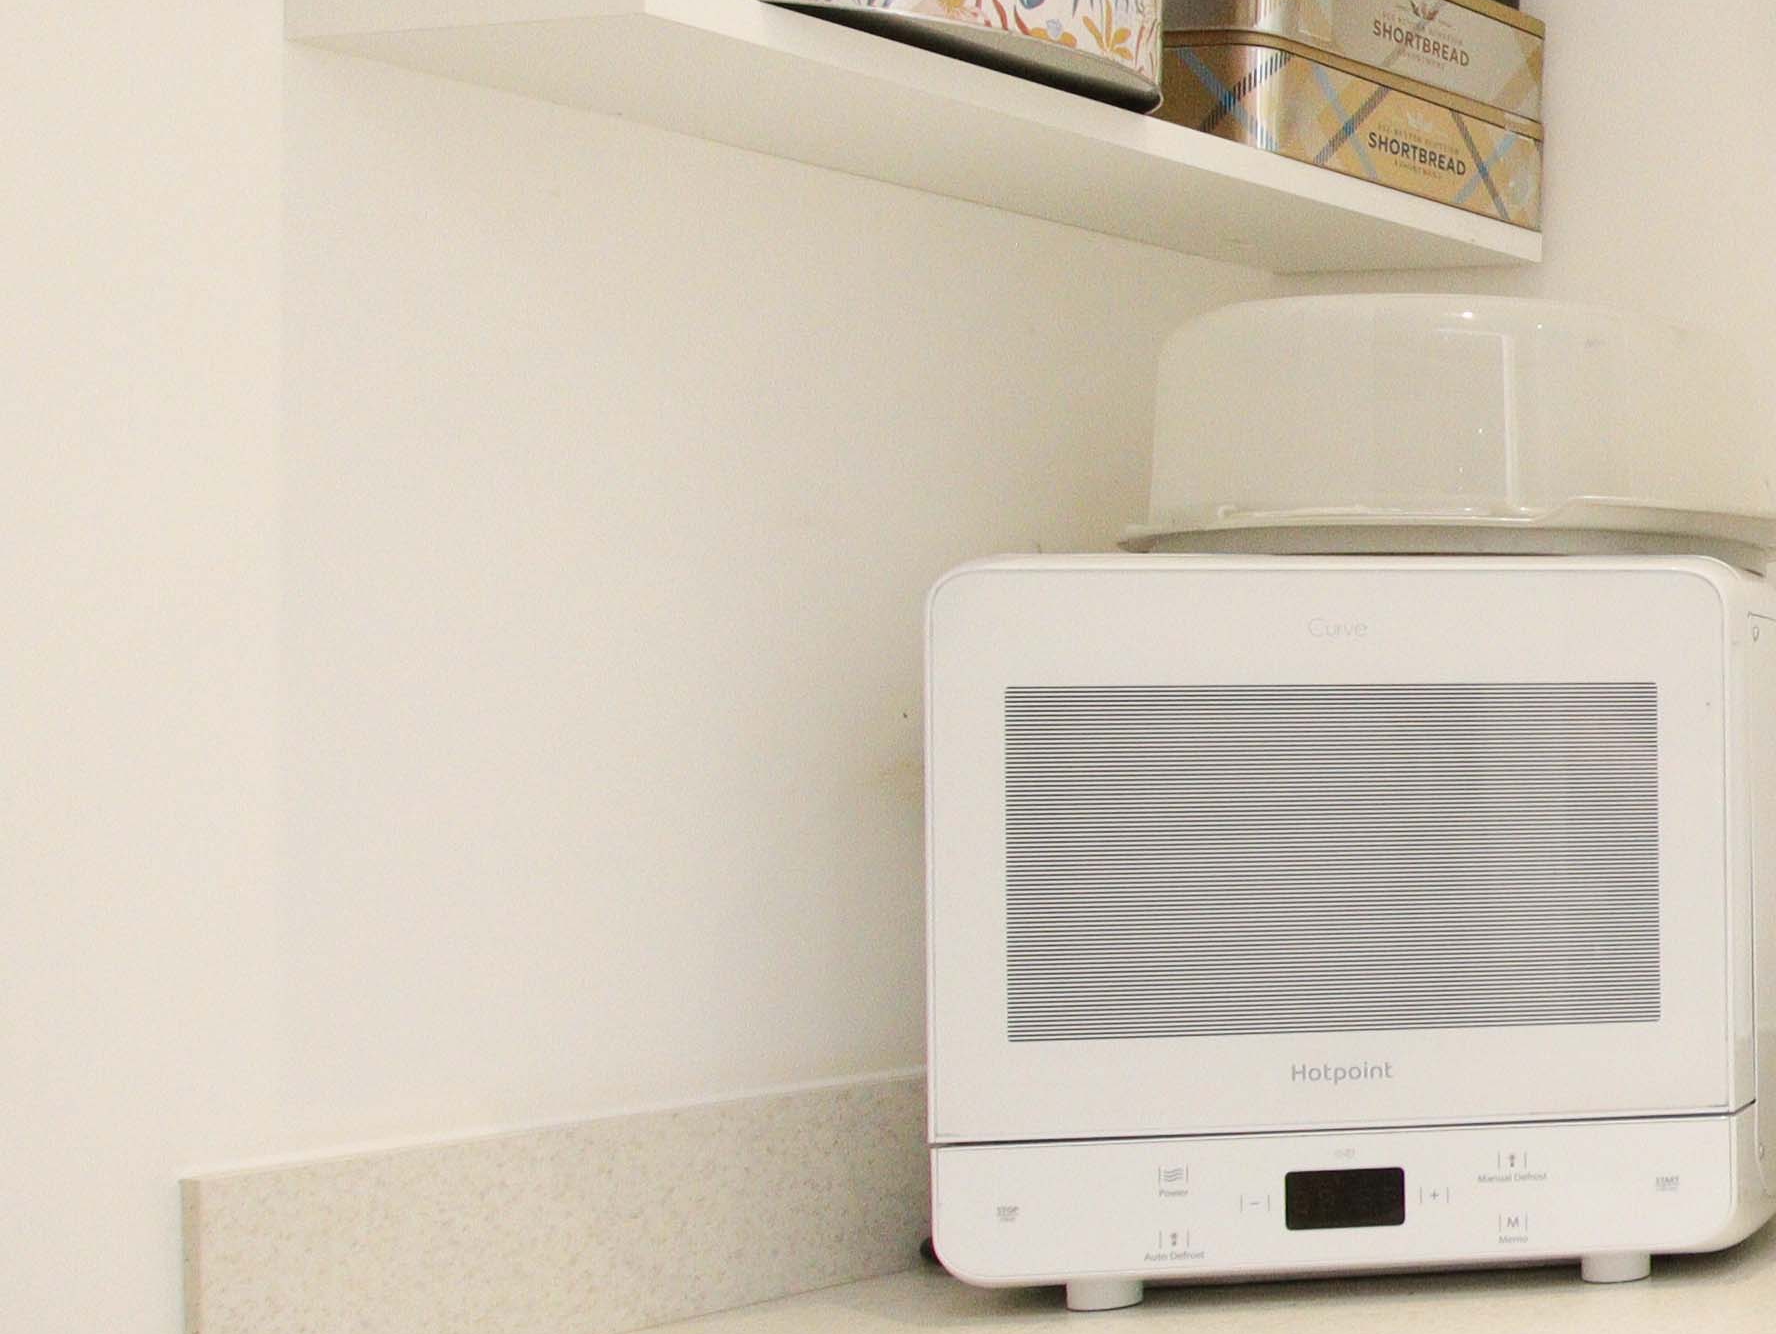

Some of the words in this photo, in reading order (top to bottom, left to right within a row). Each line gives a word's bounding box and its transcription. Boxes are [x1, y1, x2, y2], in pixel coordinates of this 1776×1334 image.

[1373, 19, 1470, 66] SHORTBREAD
[1368, 132, 1466, 176] SHORTBREAD
[1291, 1061, 1393, 1083] Hotpoint
